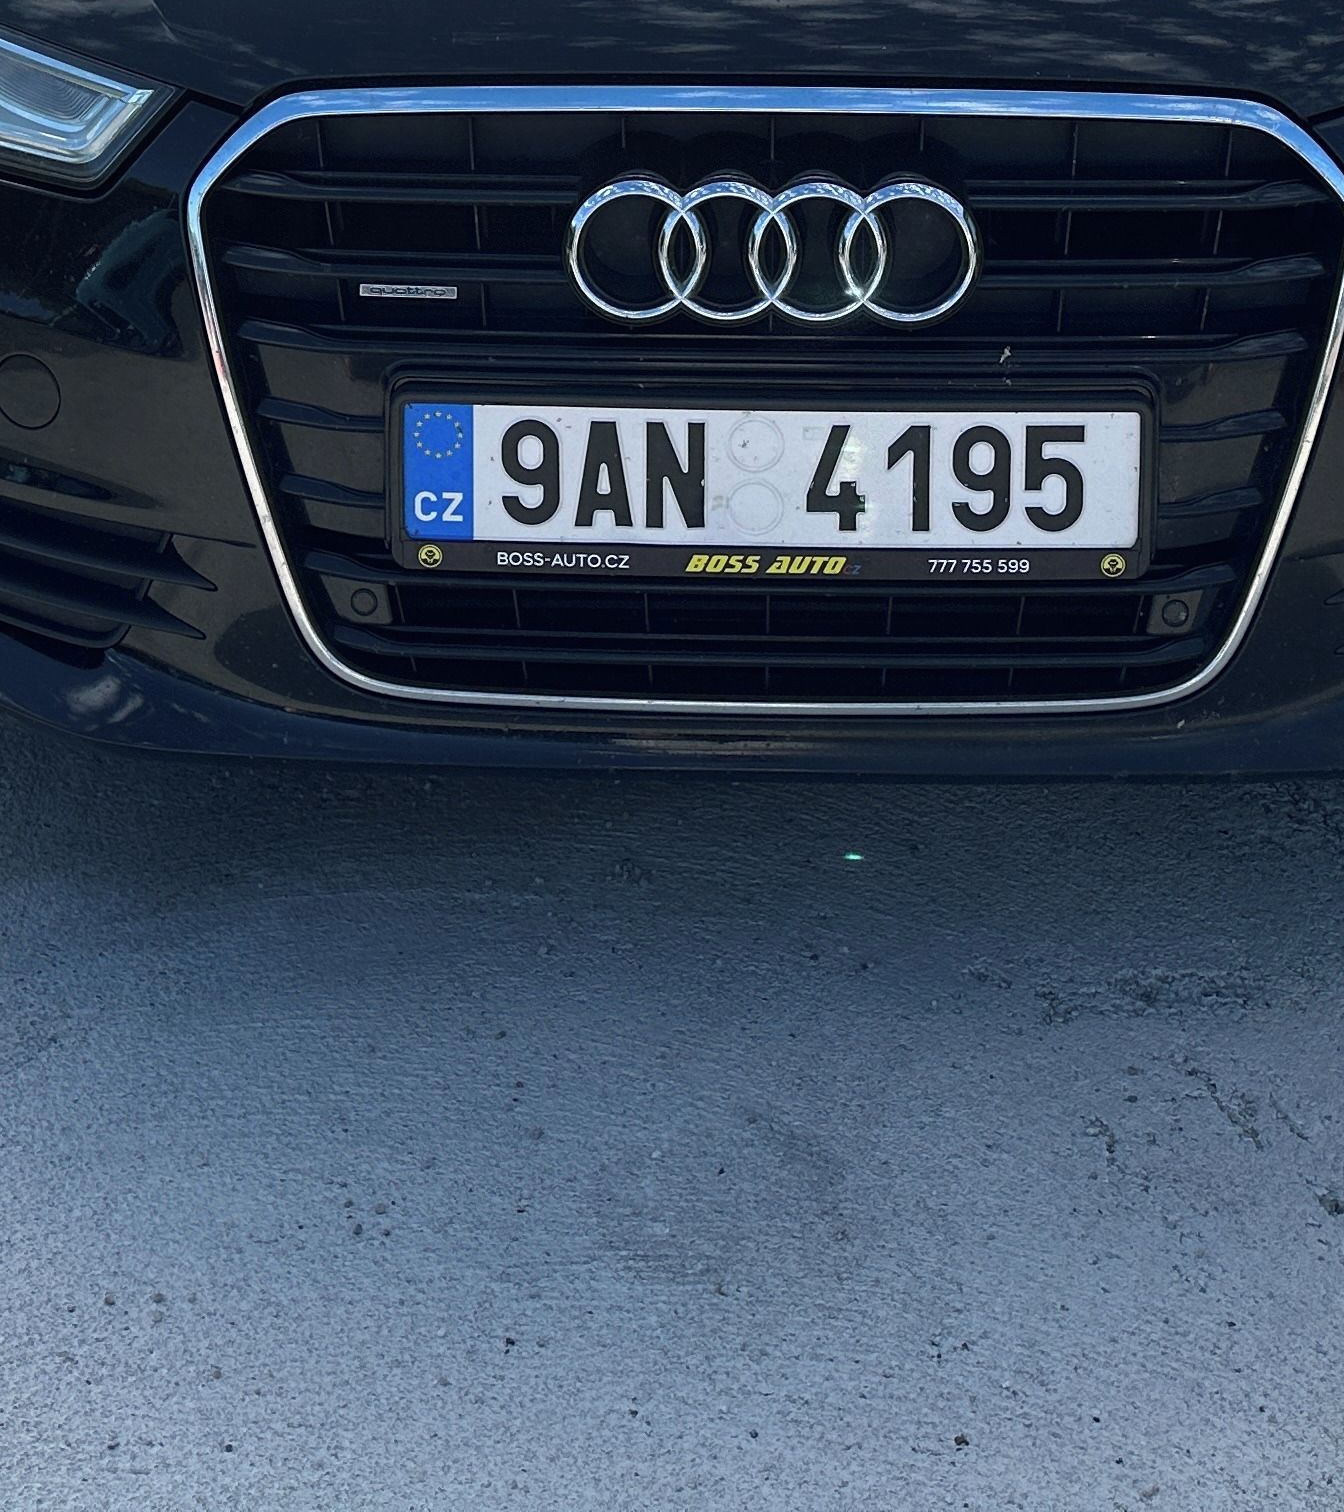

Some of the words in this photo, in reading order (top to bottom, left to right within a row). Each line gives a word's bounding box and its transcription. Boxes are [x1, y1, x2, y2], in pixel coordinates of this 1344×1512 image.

[369, 286, 446, 297] quattro
[501, 419, 706, 529] 9AN
[806, 425, 1086, 532] 4195
[414, 491, 464, 522] CZ
[496, 551, 630, 570] BOSS-AUTO.CZ
[685, 554, 759, 574] BOSS
[765, 556, 847, 575] AUTO
[928, 558, 957, 574] 777
[962, 558, 992, 574] 755
[997, 558, 1030, 575] 599
